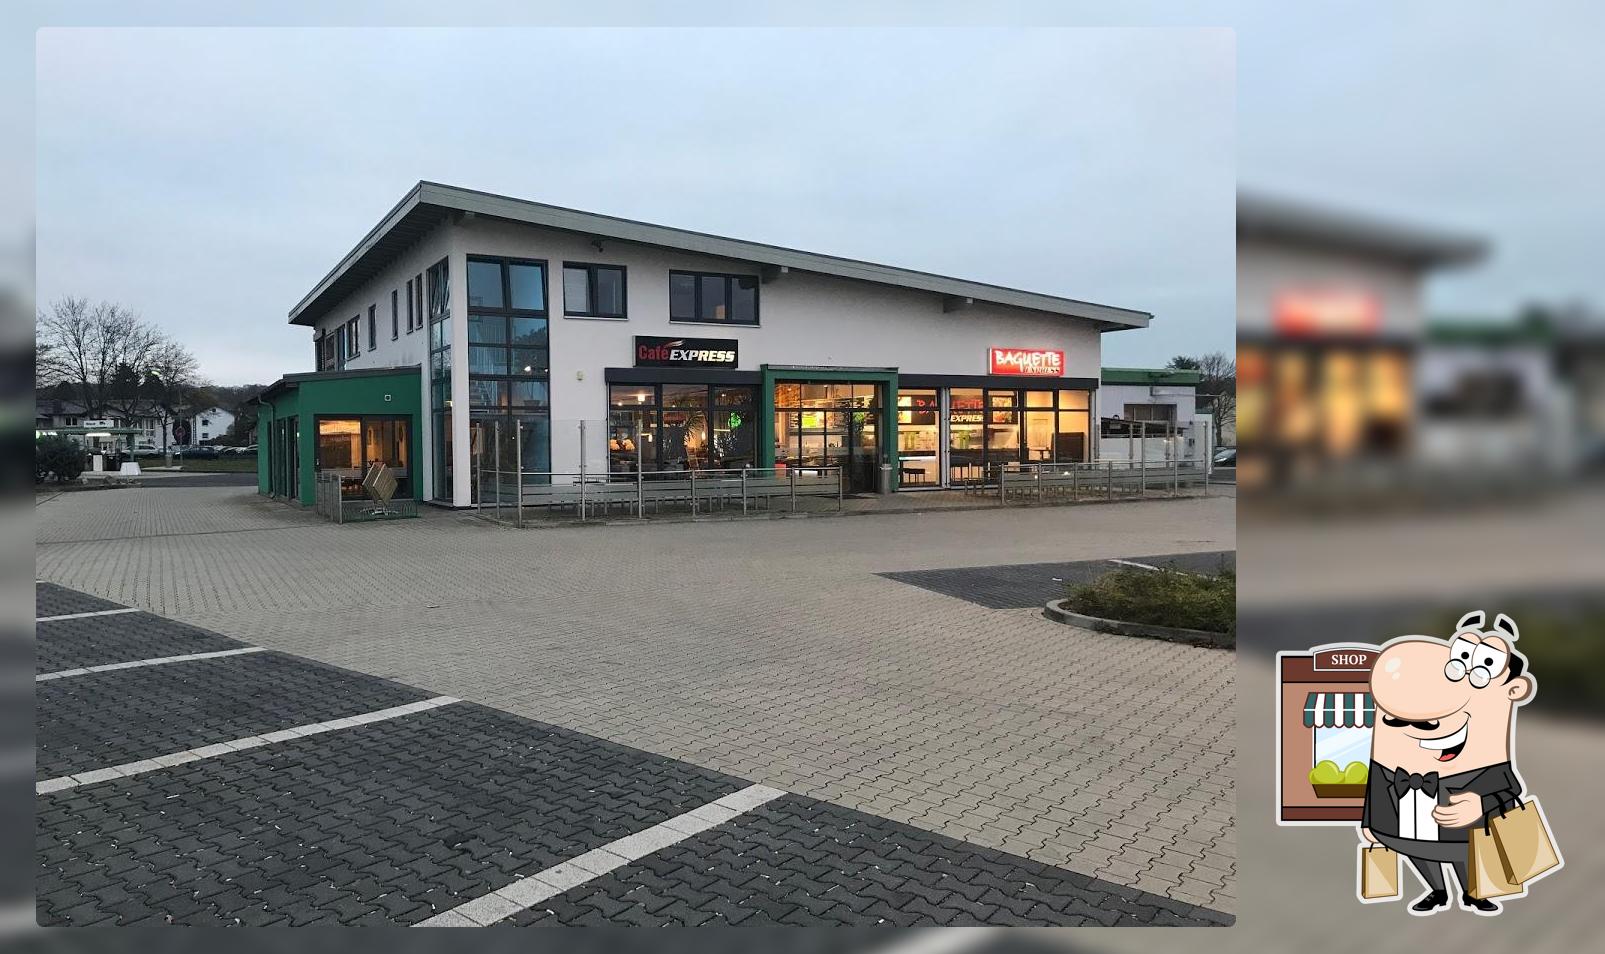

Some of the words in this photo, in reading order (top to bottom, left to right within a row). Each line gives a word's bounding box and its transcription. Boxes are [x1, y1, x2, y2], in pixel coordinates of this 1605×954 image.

[669, 349, 736, 362] EXPRESS
[994, 349, 1062, 372] BAGUETTE
[950, 414, 983, 422] EXPRES
